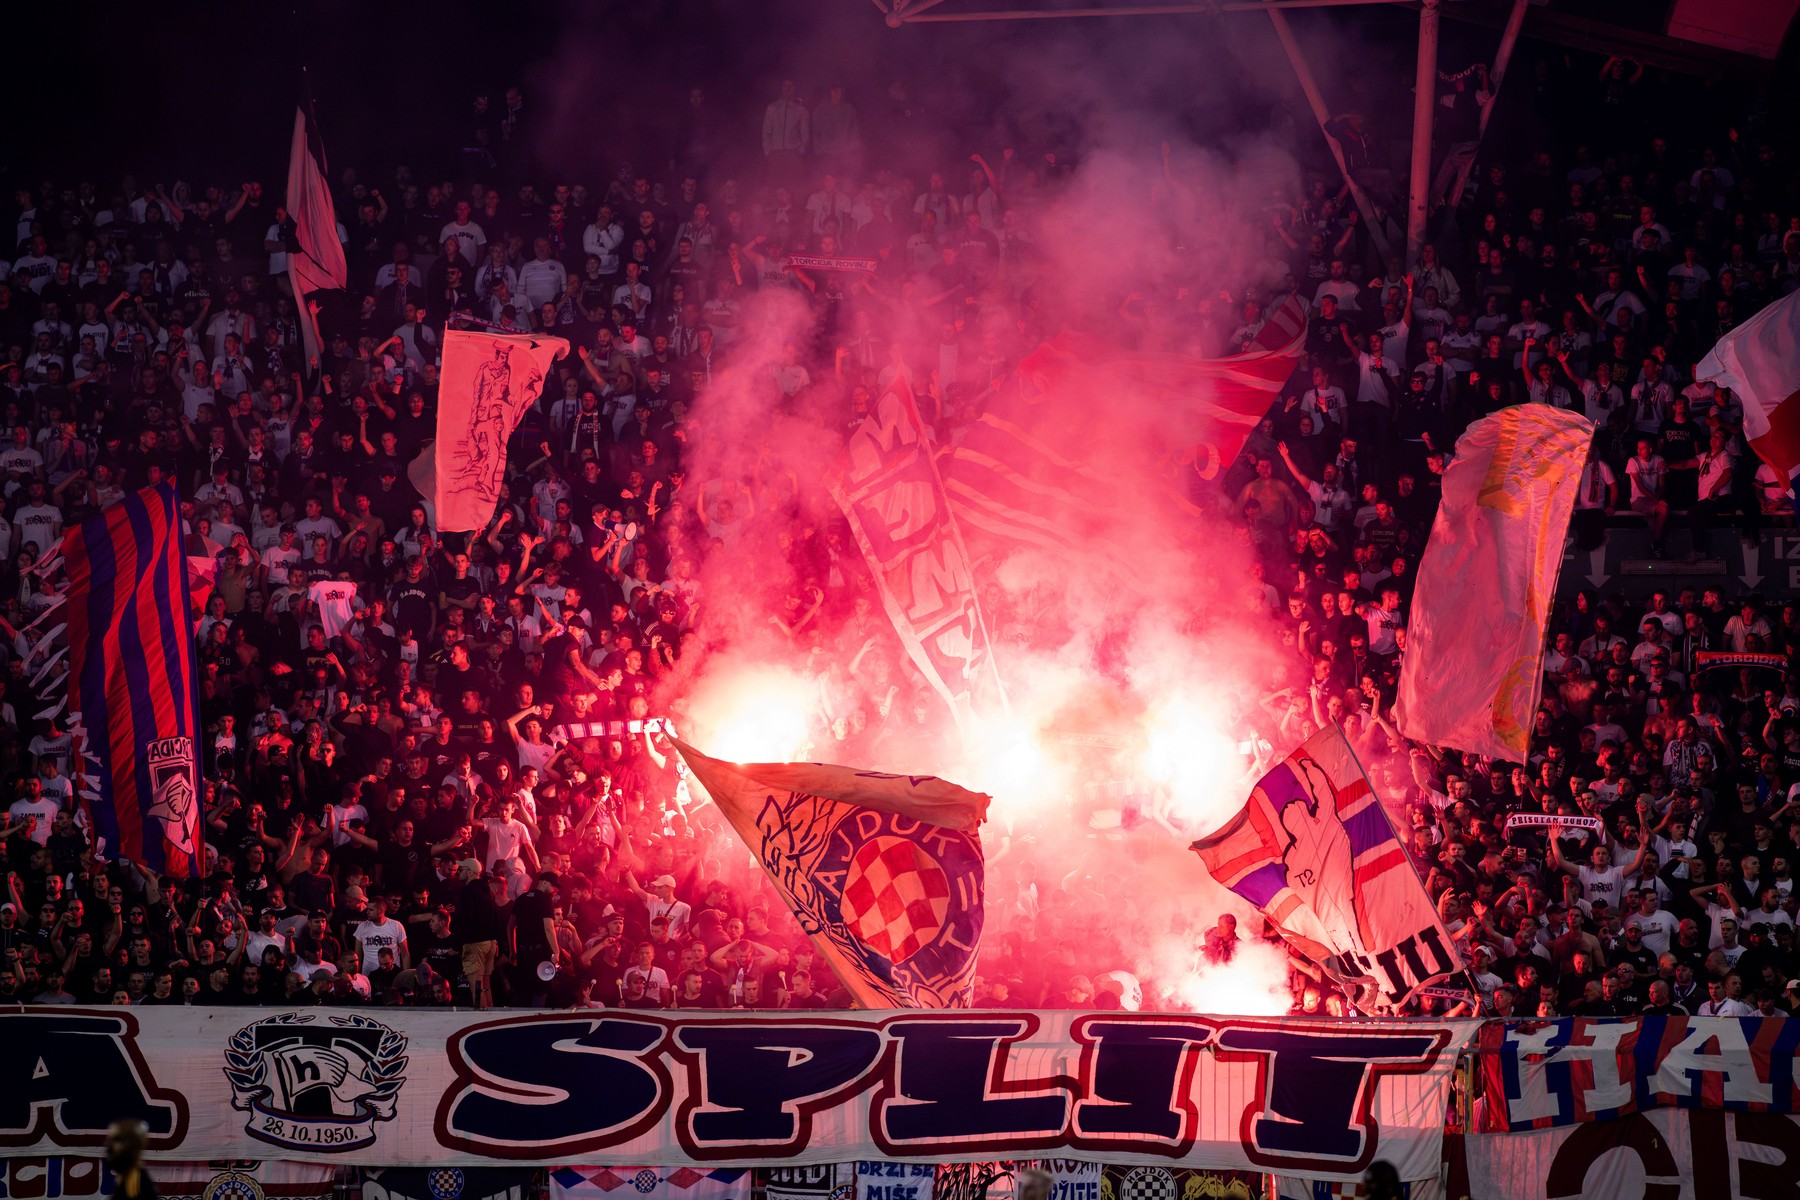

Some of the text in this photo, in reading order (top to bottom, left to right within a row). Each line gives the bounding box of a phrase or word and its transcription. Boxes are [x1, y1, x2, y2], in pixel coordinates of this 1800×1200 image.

[795, 258, 831, 267] TORCIDA
[815, 810, 961, 897] AJDUK
[434, 1010, 1452, 1174] SPLIT
[1504, 1015, 1800, 1124] HA
[1126, 1166, 1169, 1185] HAJDUK
